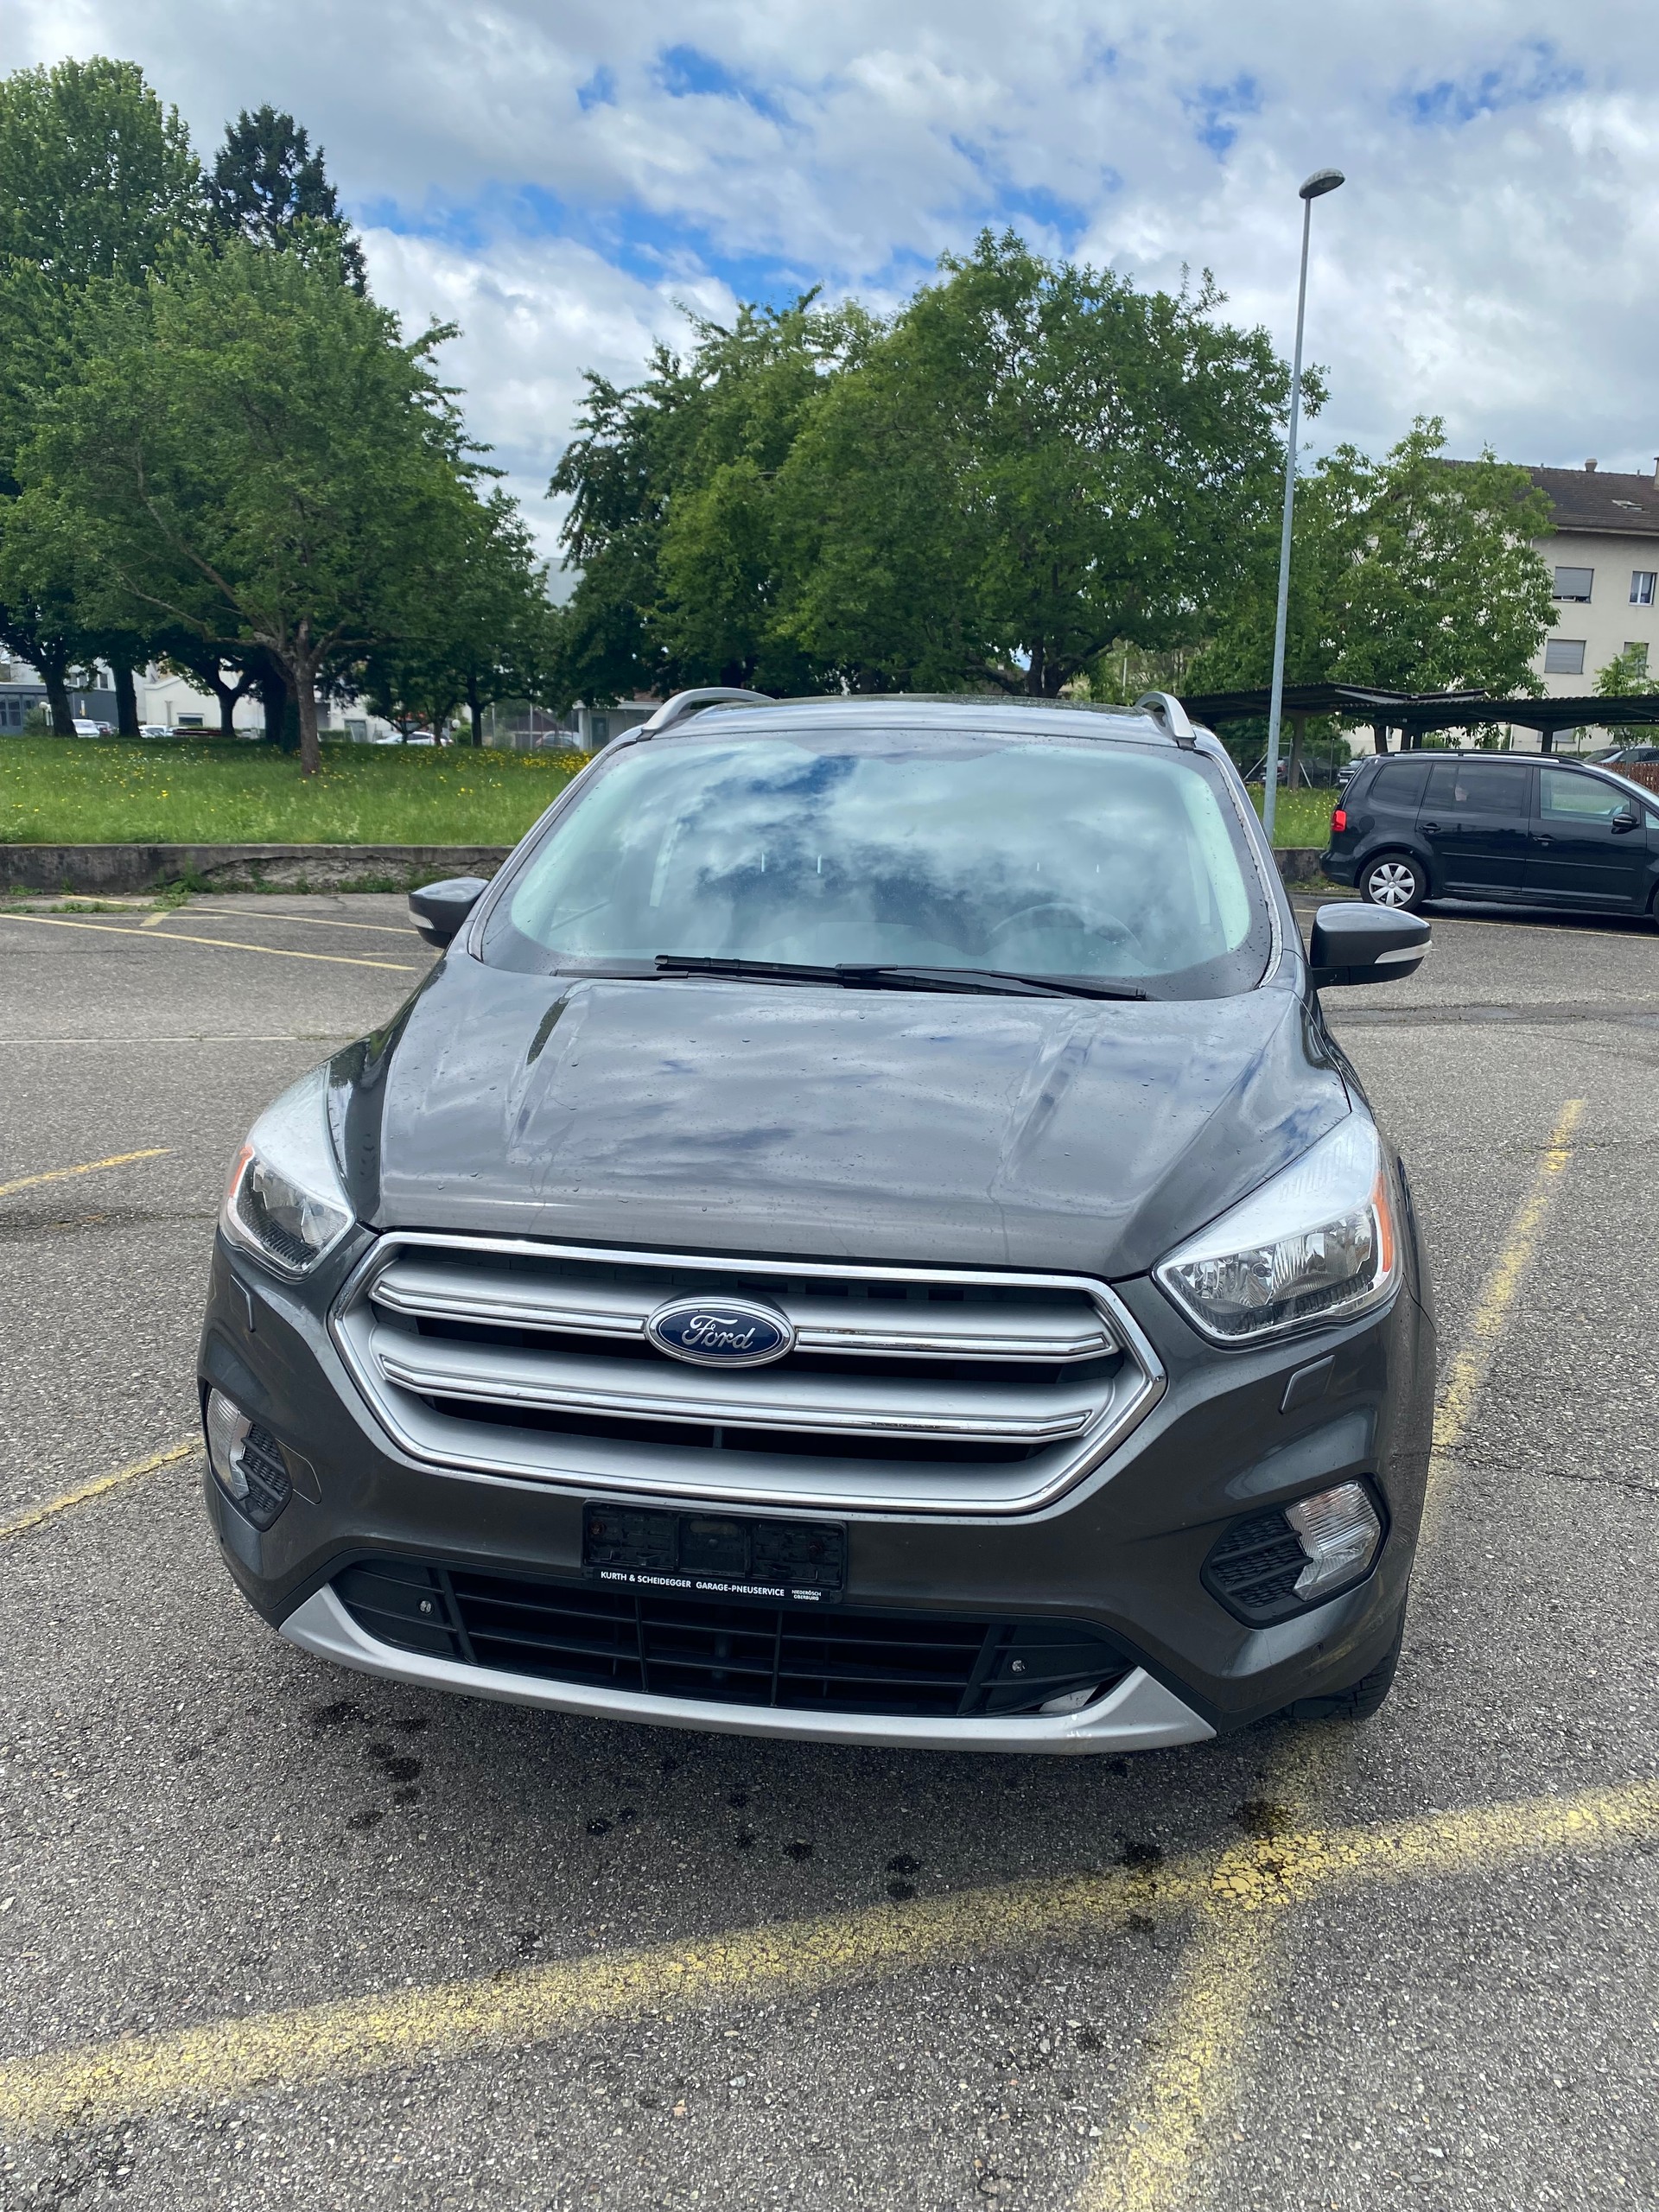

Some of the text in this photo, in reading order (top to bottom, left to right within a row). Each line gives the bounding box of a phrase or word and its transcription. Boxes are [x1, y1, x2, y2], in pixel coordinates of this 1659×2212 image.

[681, 1314, 756, 1351] Ford
[601, 1571, 627, 1581] KURTH
[637, 1575, 691, 1588] SCHEIDEGGER
[696, 1581, 785, 1597] GARAGE-PNEUSERVICE
